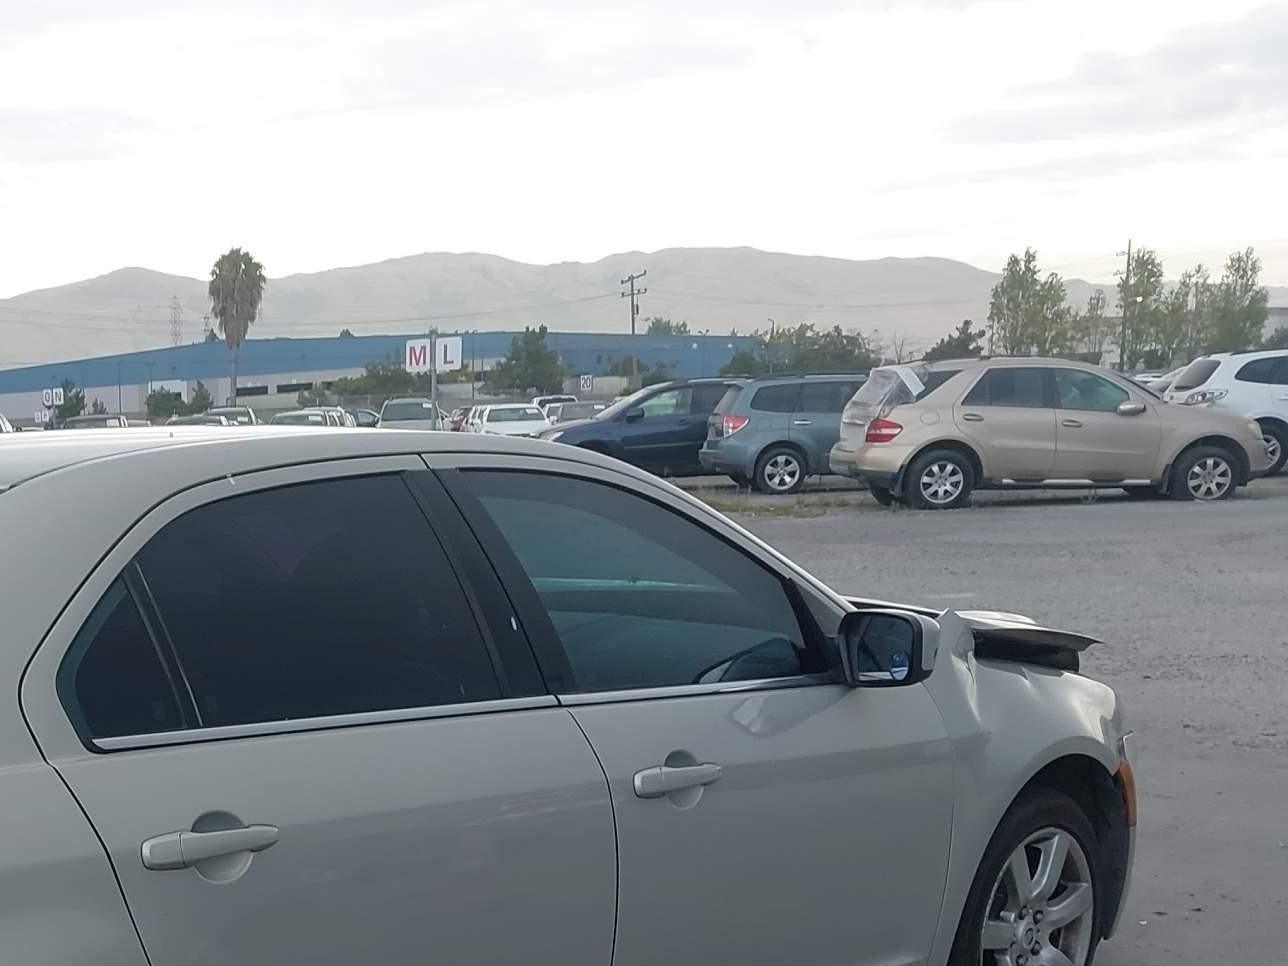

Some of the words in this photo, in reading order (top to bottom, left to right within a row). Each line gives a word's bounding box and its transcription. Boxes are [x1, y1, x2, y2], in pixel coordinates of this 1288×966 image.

[409, 345, 426, 366] M
[444, 344, 454, 364] L
[582, 376, 591, 388] 20
